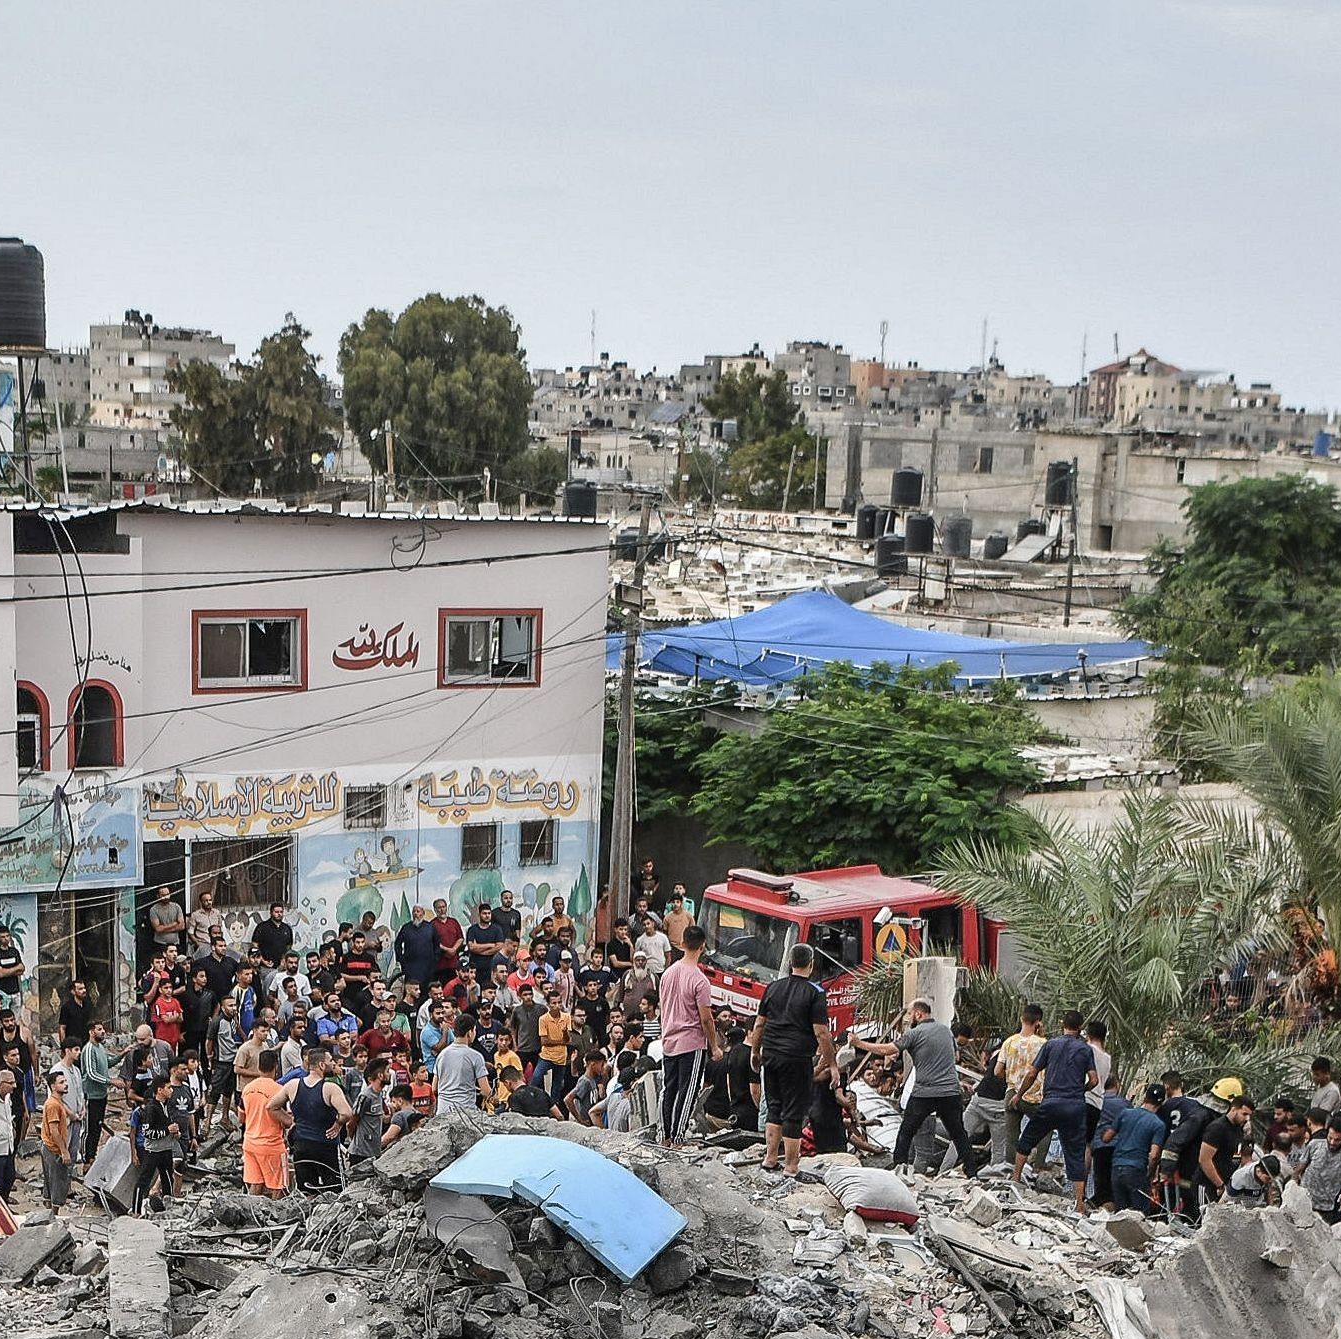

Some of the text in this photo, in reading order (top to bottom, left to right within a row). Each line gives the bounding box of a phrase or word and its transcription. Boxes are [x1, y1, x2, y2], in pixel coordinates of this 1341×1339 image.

[332, 621, 419, 670] الملك
[418, 767, 491, 817] طيبة
[496, 768, 574, 811] روضة
